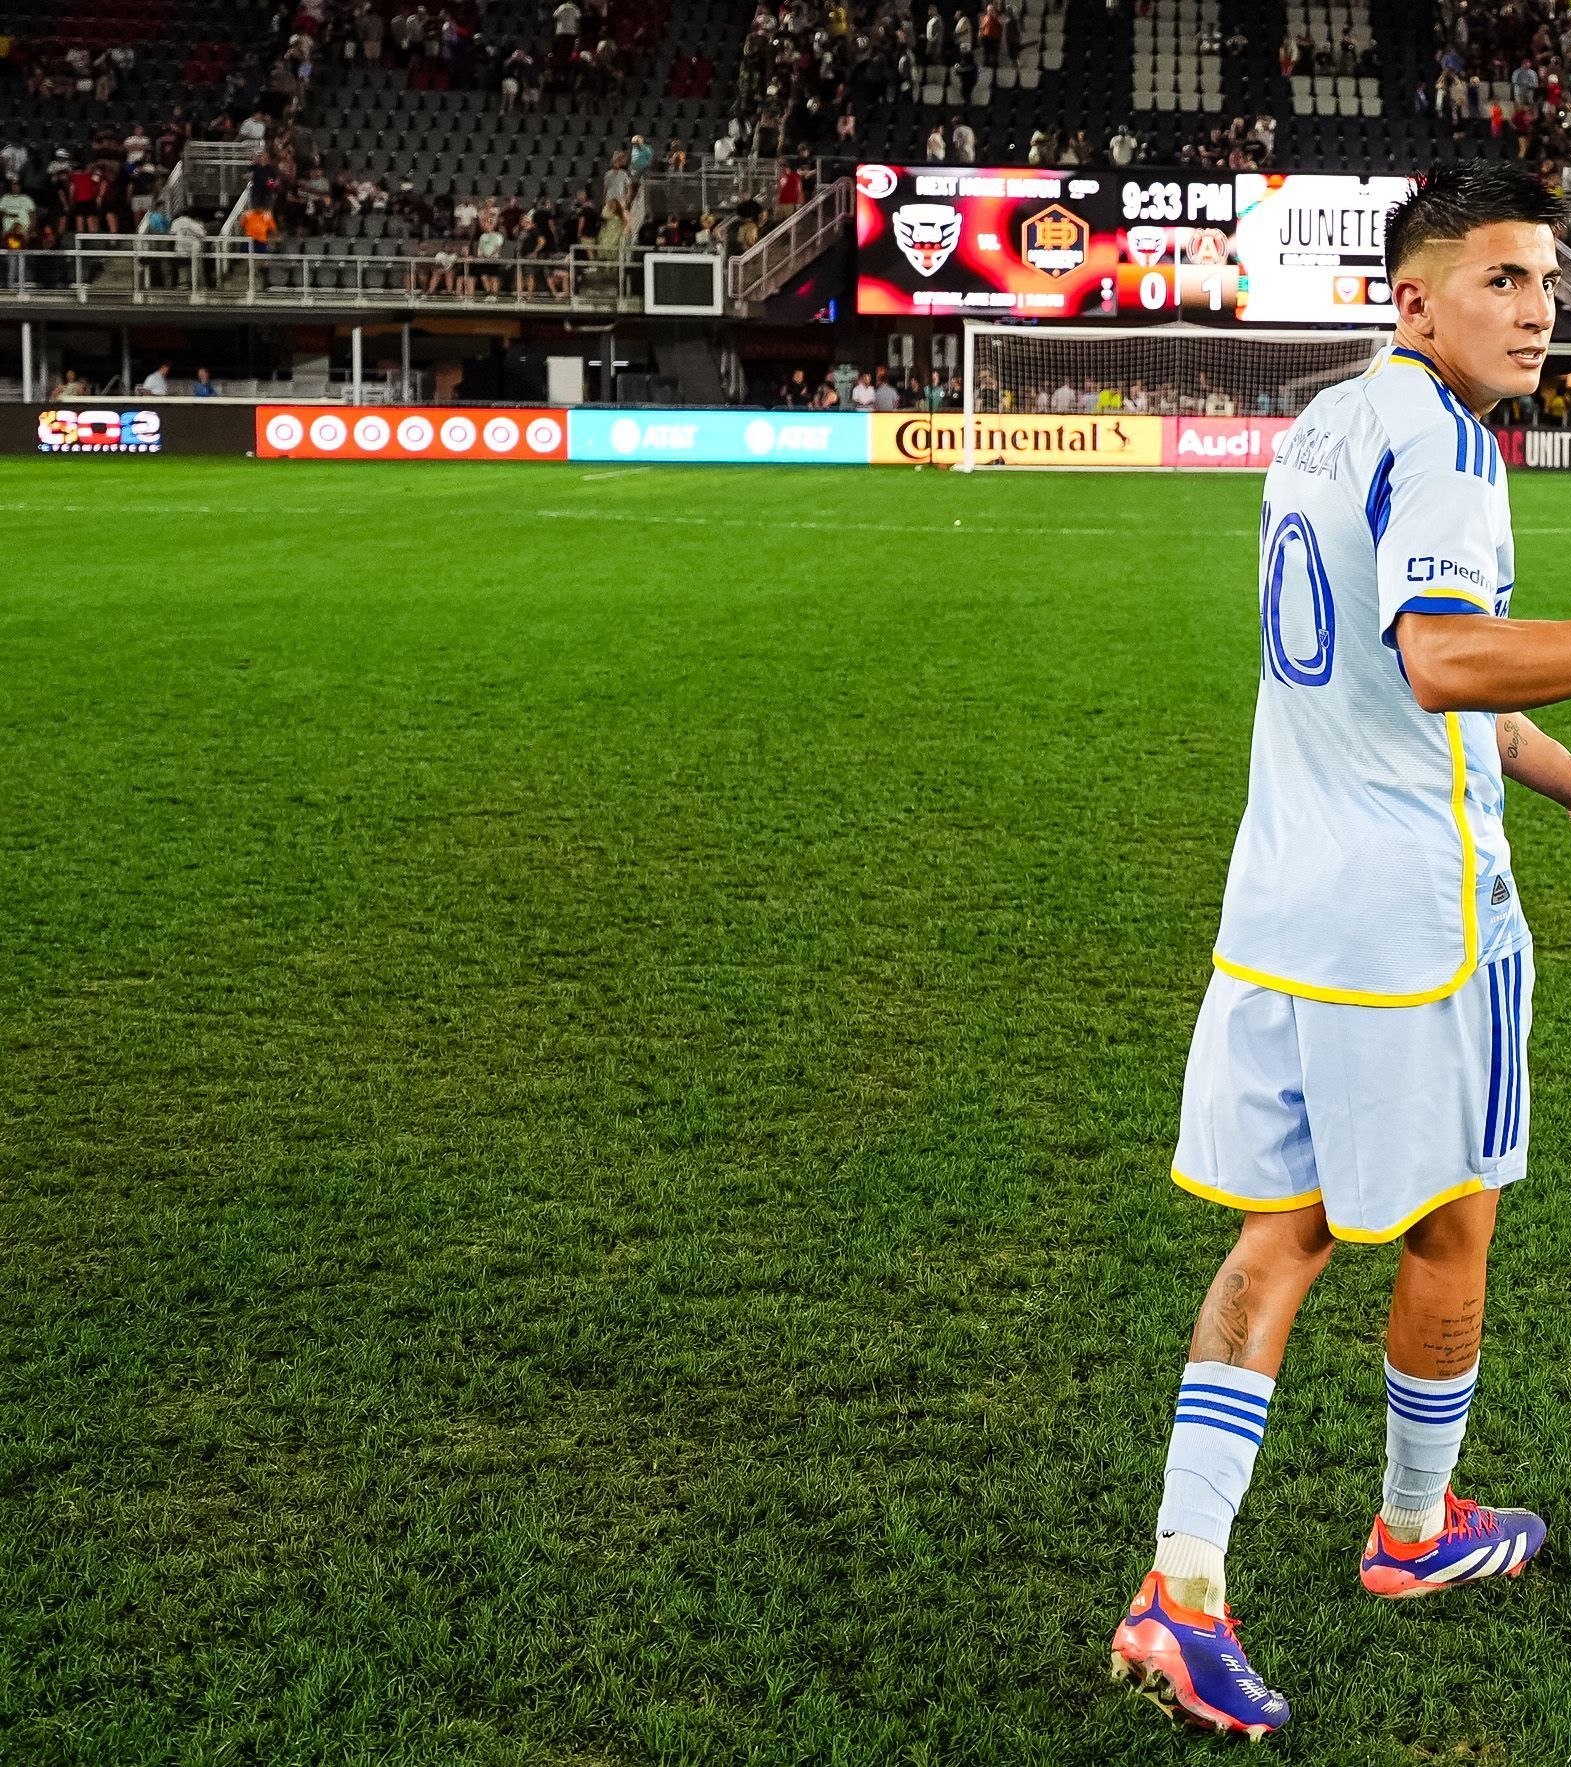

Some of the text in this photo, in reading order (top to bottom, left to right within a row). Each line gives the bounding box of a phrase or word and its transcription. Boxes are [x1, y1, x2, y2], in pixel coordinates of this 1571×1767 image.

[916, 176, 958, 196] NEXT
[1122, 181, 1182, 220] 9:33
[1187, 182, 1233, 221] PM
[1280, 208, 1380, 247] JUNETE
[1140, 271, 1167, 310] 0
[1201, 273, 1222, 311] 1
[643, 424, 699, 449] AT&T
[777, 425, 832, 450] AT&T
[896, 419, 1098, 460] Coninental
[1178, 429, 1260, 455] Audi
